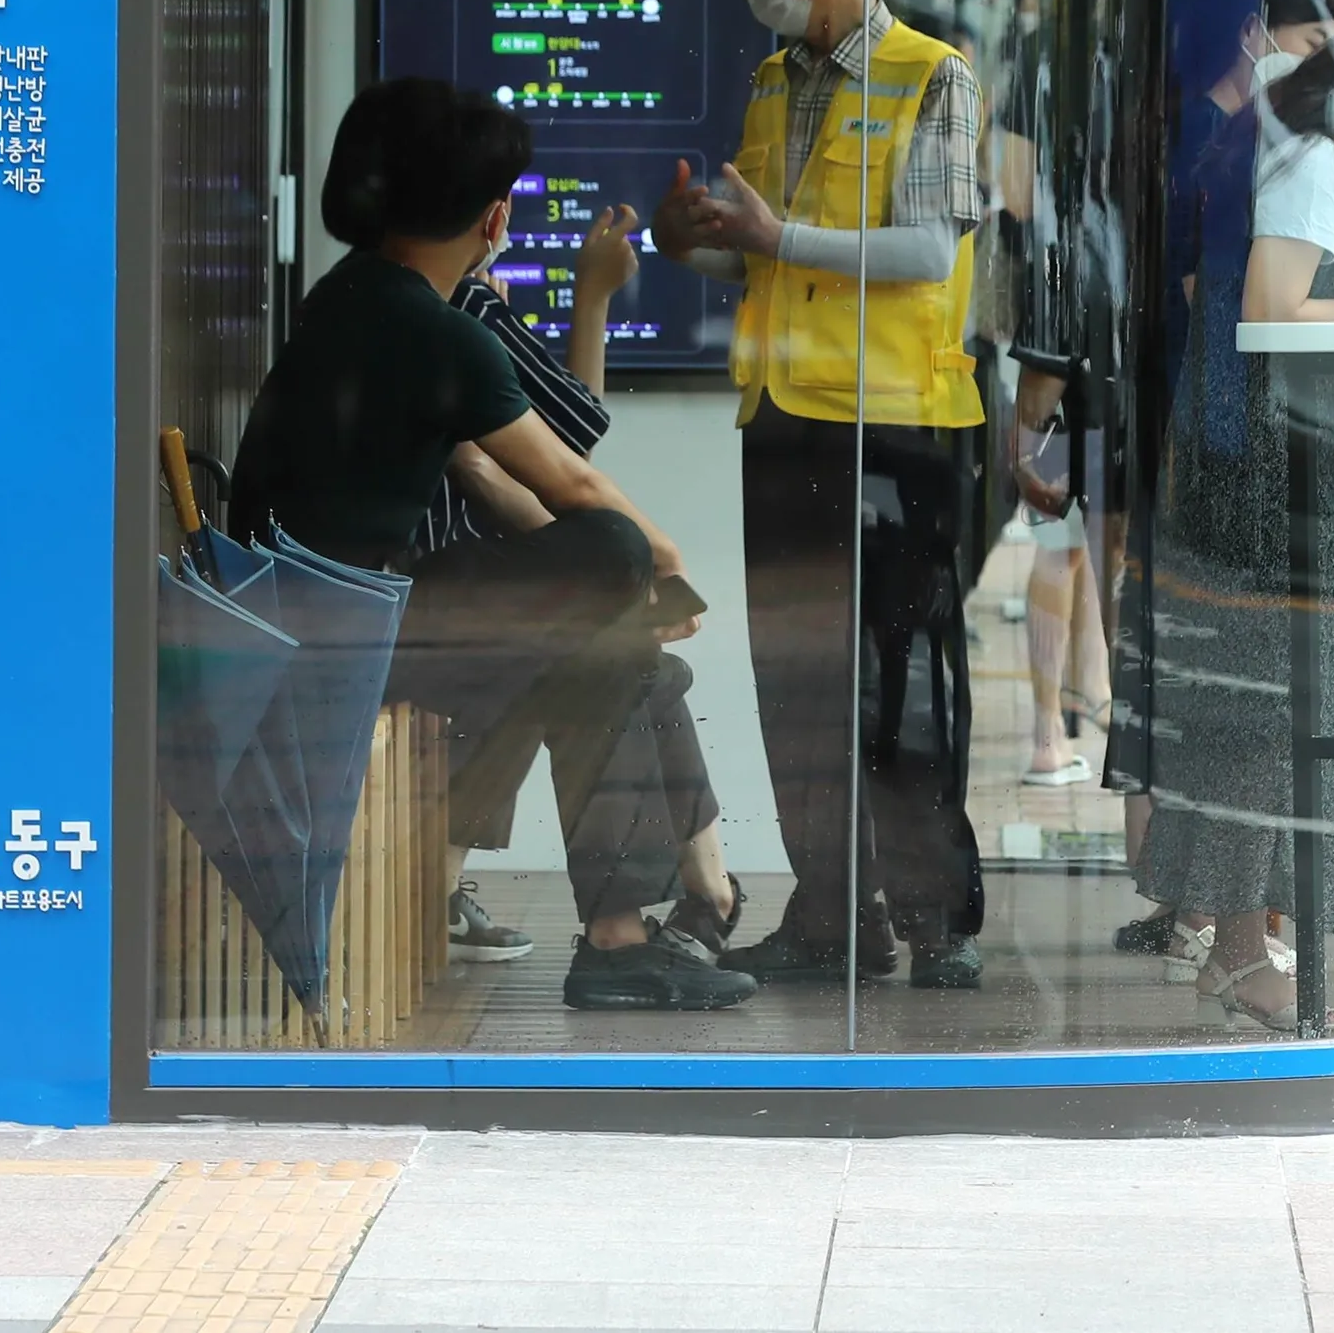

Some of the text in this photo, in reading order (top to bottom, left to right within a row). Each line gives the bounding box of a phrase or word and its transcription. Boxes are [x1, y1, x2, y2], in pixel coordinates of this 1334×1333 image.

[547, 57, 557, 78] 1
[2, 166, 46, 194] 제공
[546, 199, 561, 222] 3
[546, 289, 556, 309] 1
